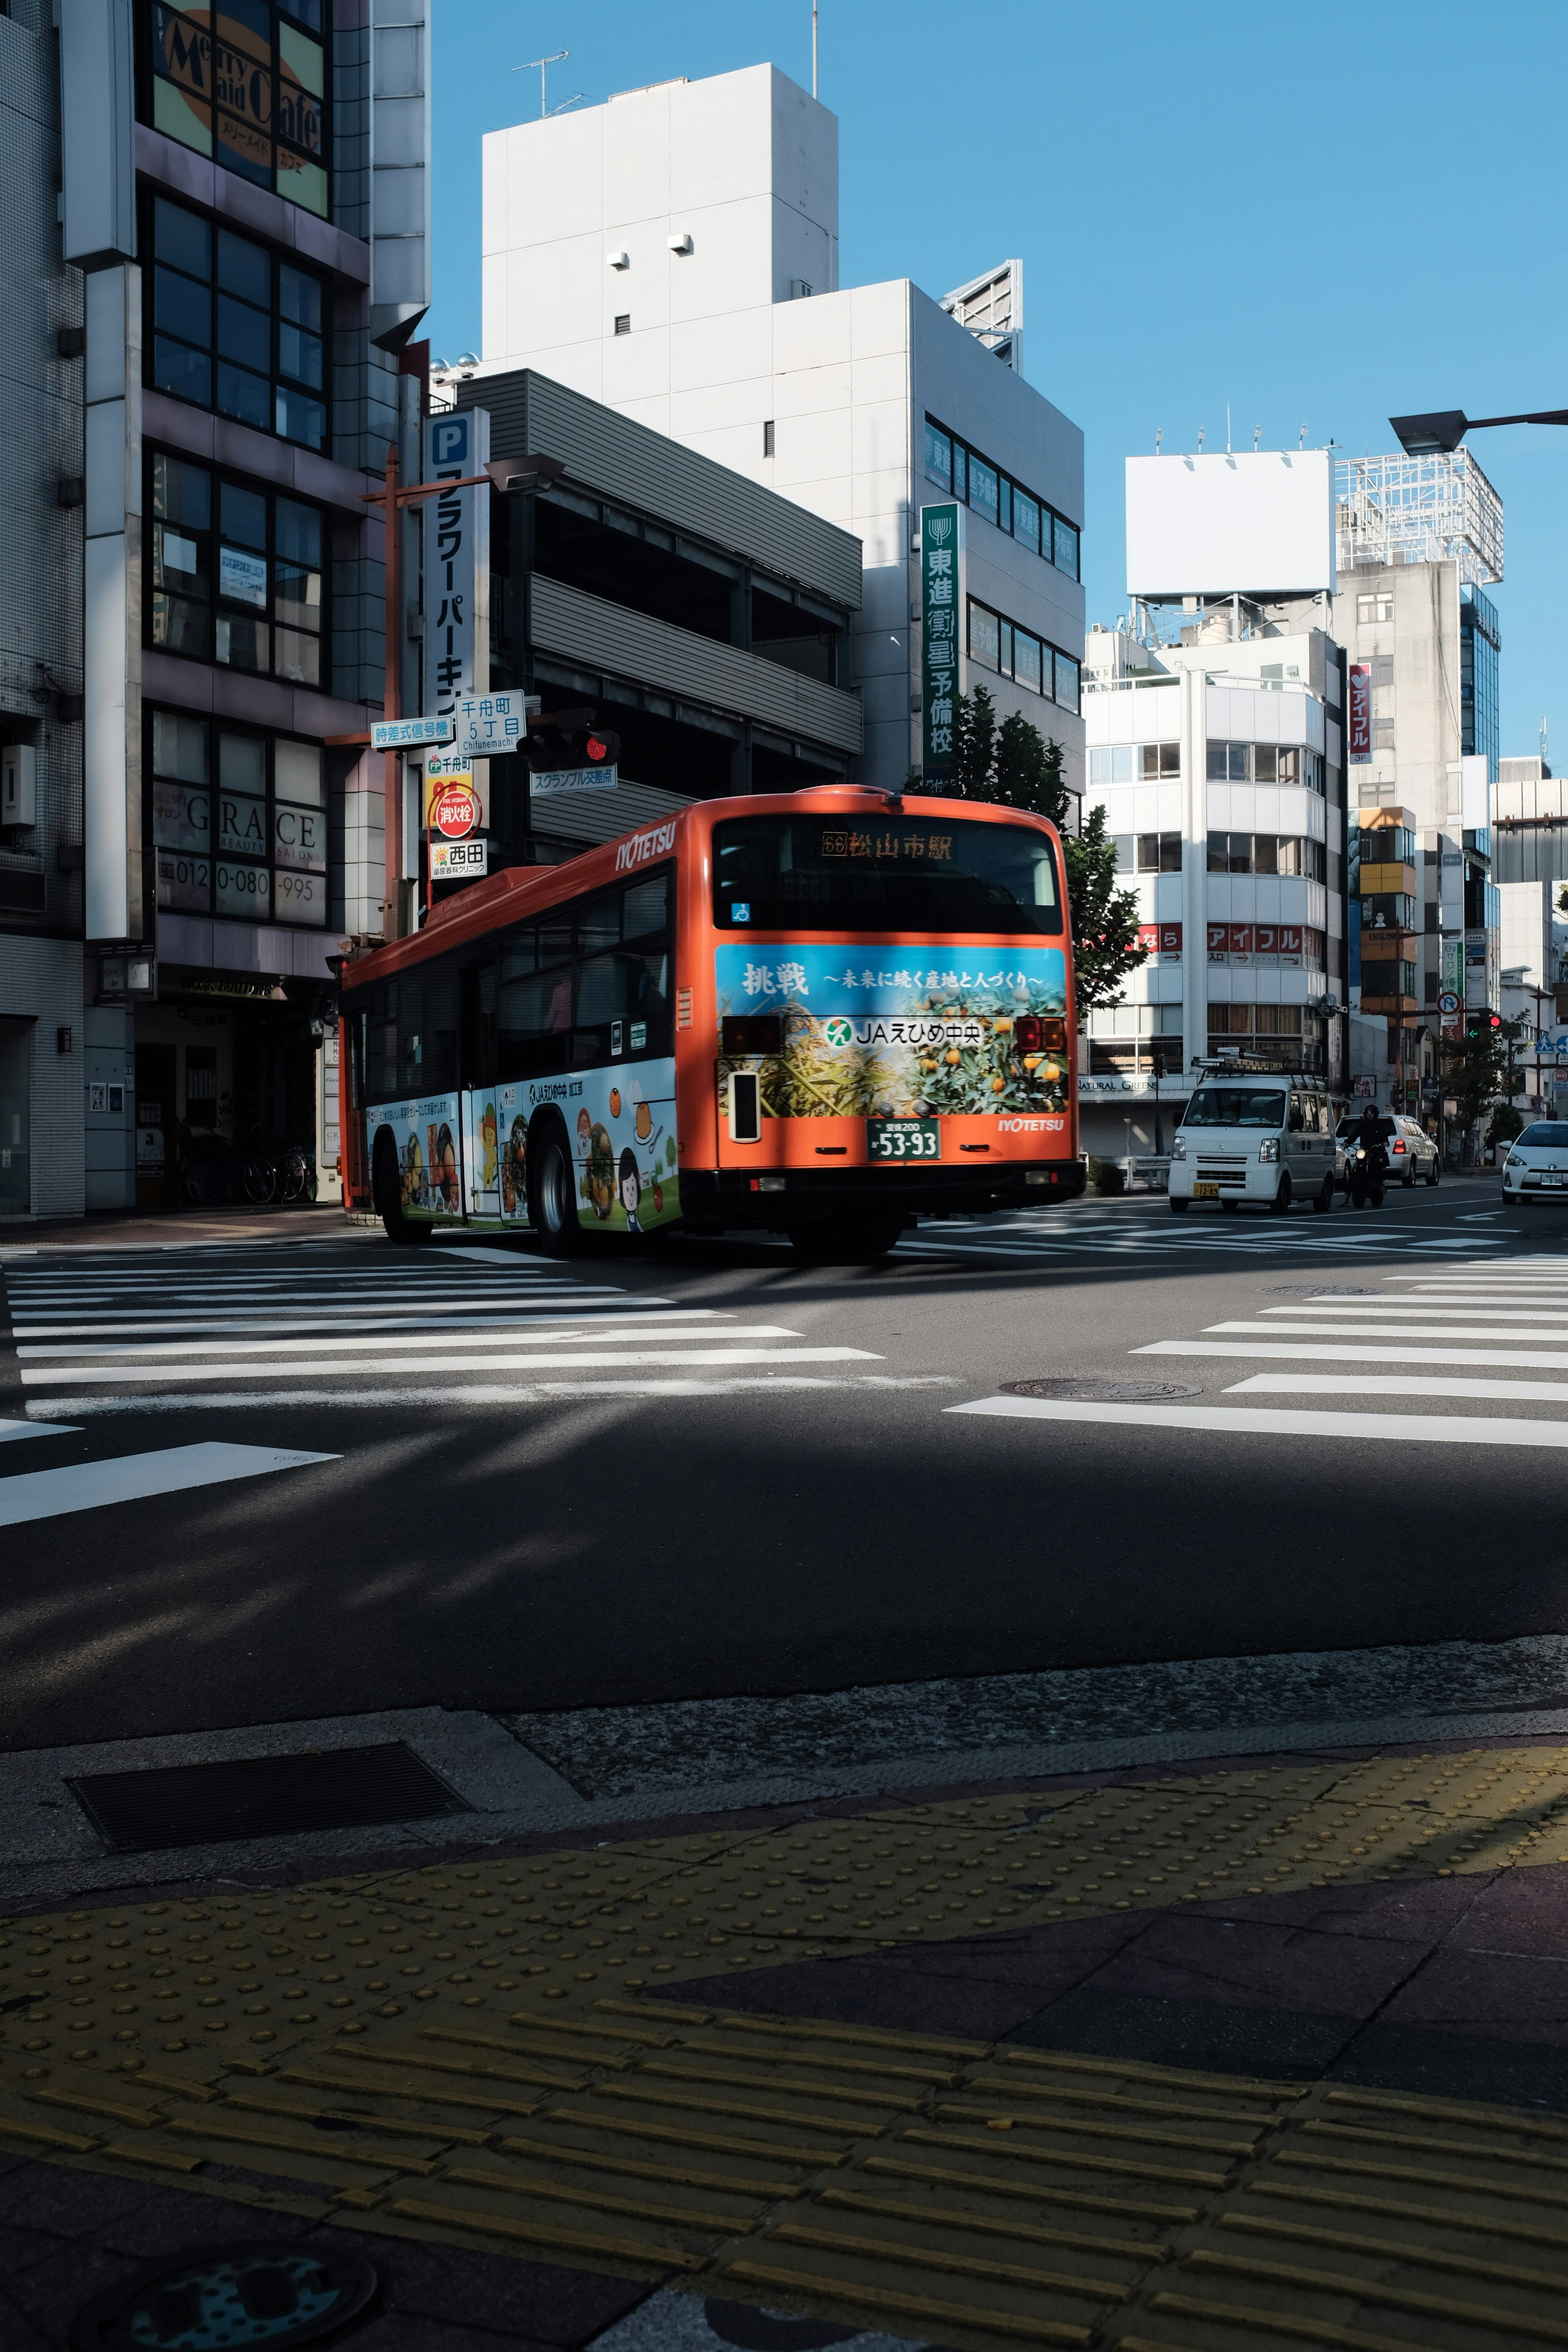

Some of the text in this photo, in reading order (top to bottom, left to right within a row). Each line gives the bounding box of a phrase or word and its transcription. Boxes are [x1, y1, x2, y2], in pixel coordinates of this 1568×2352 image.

[438, 426, 461, 459] P
[437, 469, 462, 749] フラワーパーキン
[928, 548, 955, 754] 東進衛星予備校
[462, 698, 510, 719] 千舟町
[1353, 690, 1368, 747] アイフル
[376, 720, 448, 742] 時差式信号機
[470, 717, 519, 740] 5丁目
[463, 739, 513, 750] Chifunemachi
[443, 756, 470, 772] 千舟町
[535, 769, 612, 790] スクランブル交差点
[187, 796, 315, 848] GRACE
[440, 804, 472, 824] 消火栓
[221, 837, 313, 861] BEAUTY SALON
[450, 844, 483, 865] 西田
[615, 821, 677, 871] IYOTETSU
[849, 832, 952, 860] 松山市駅
[177, 862, 313, 900] 0120-080-995
[433, 864, 485, 875] 泌尿器科クリニック
[1208, 927, 1300, 950] アイフル
[1209, 953, 1224, 961] 入口
[742, 962, 810, 996] 挑戦
[856, 1022, 982, 1045] JAえひめ中央
[536, 1082, 567, 1103] JAえひめ中央
[998, 1118, 1064, 1133] IYOTETSU
[879, 1133, 937, 1156] 53-93
